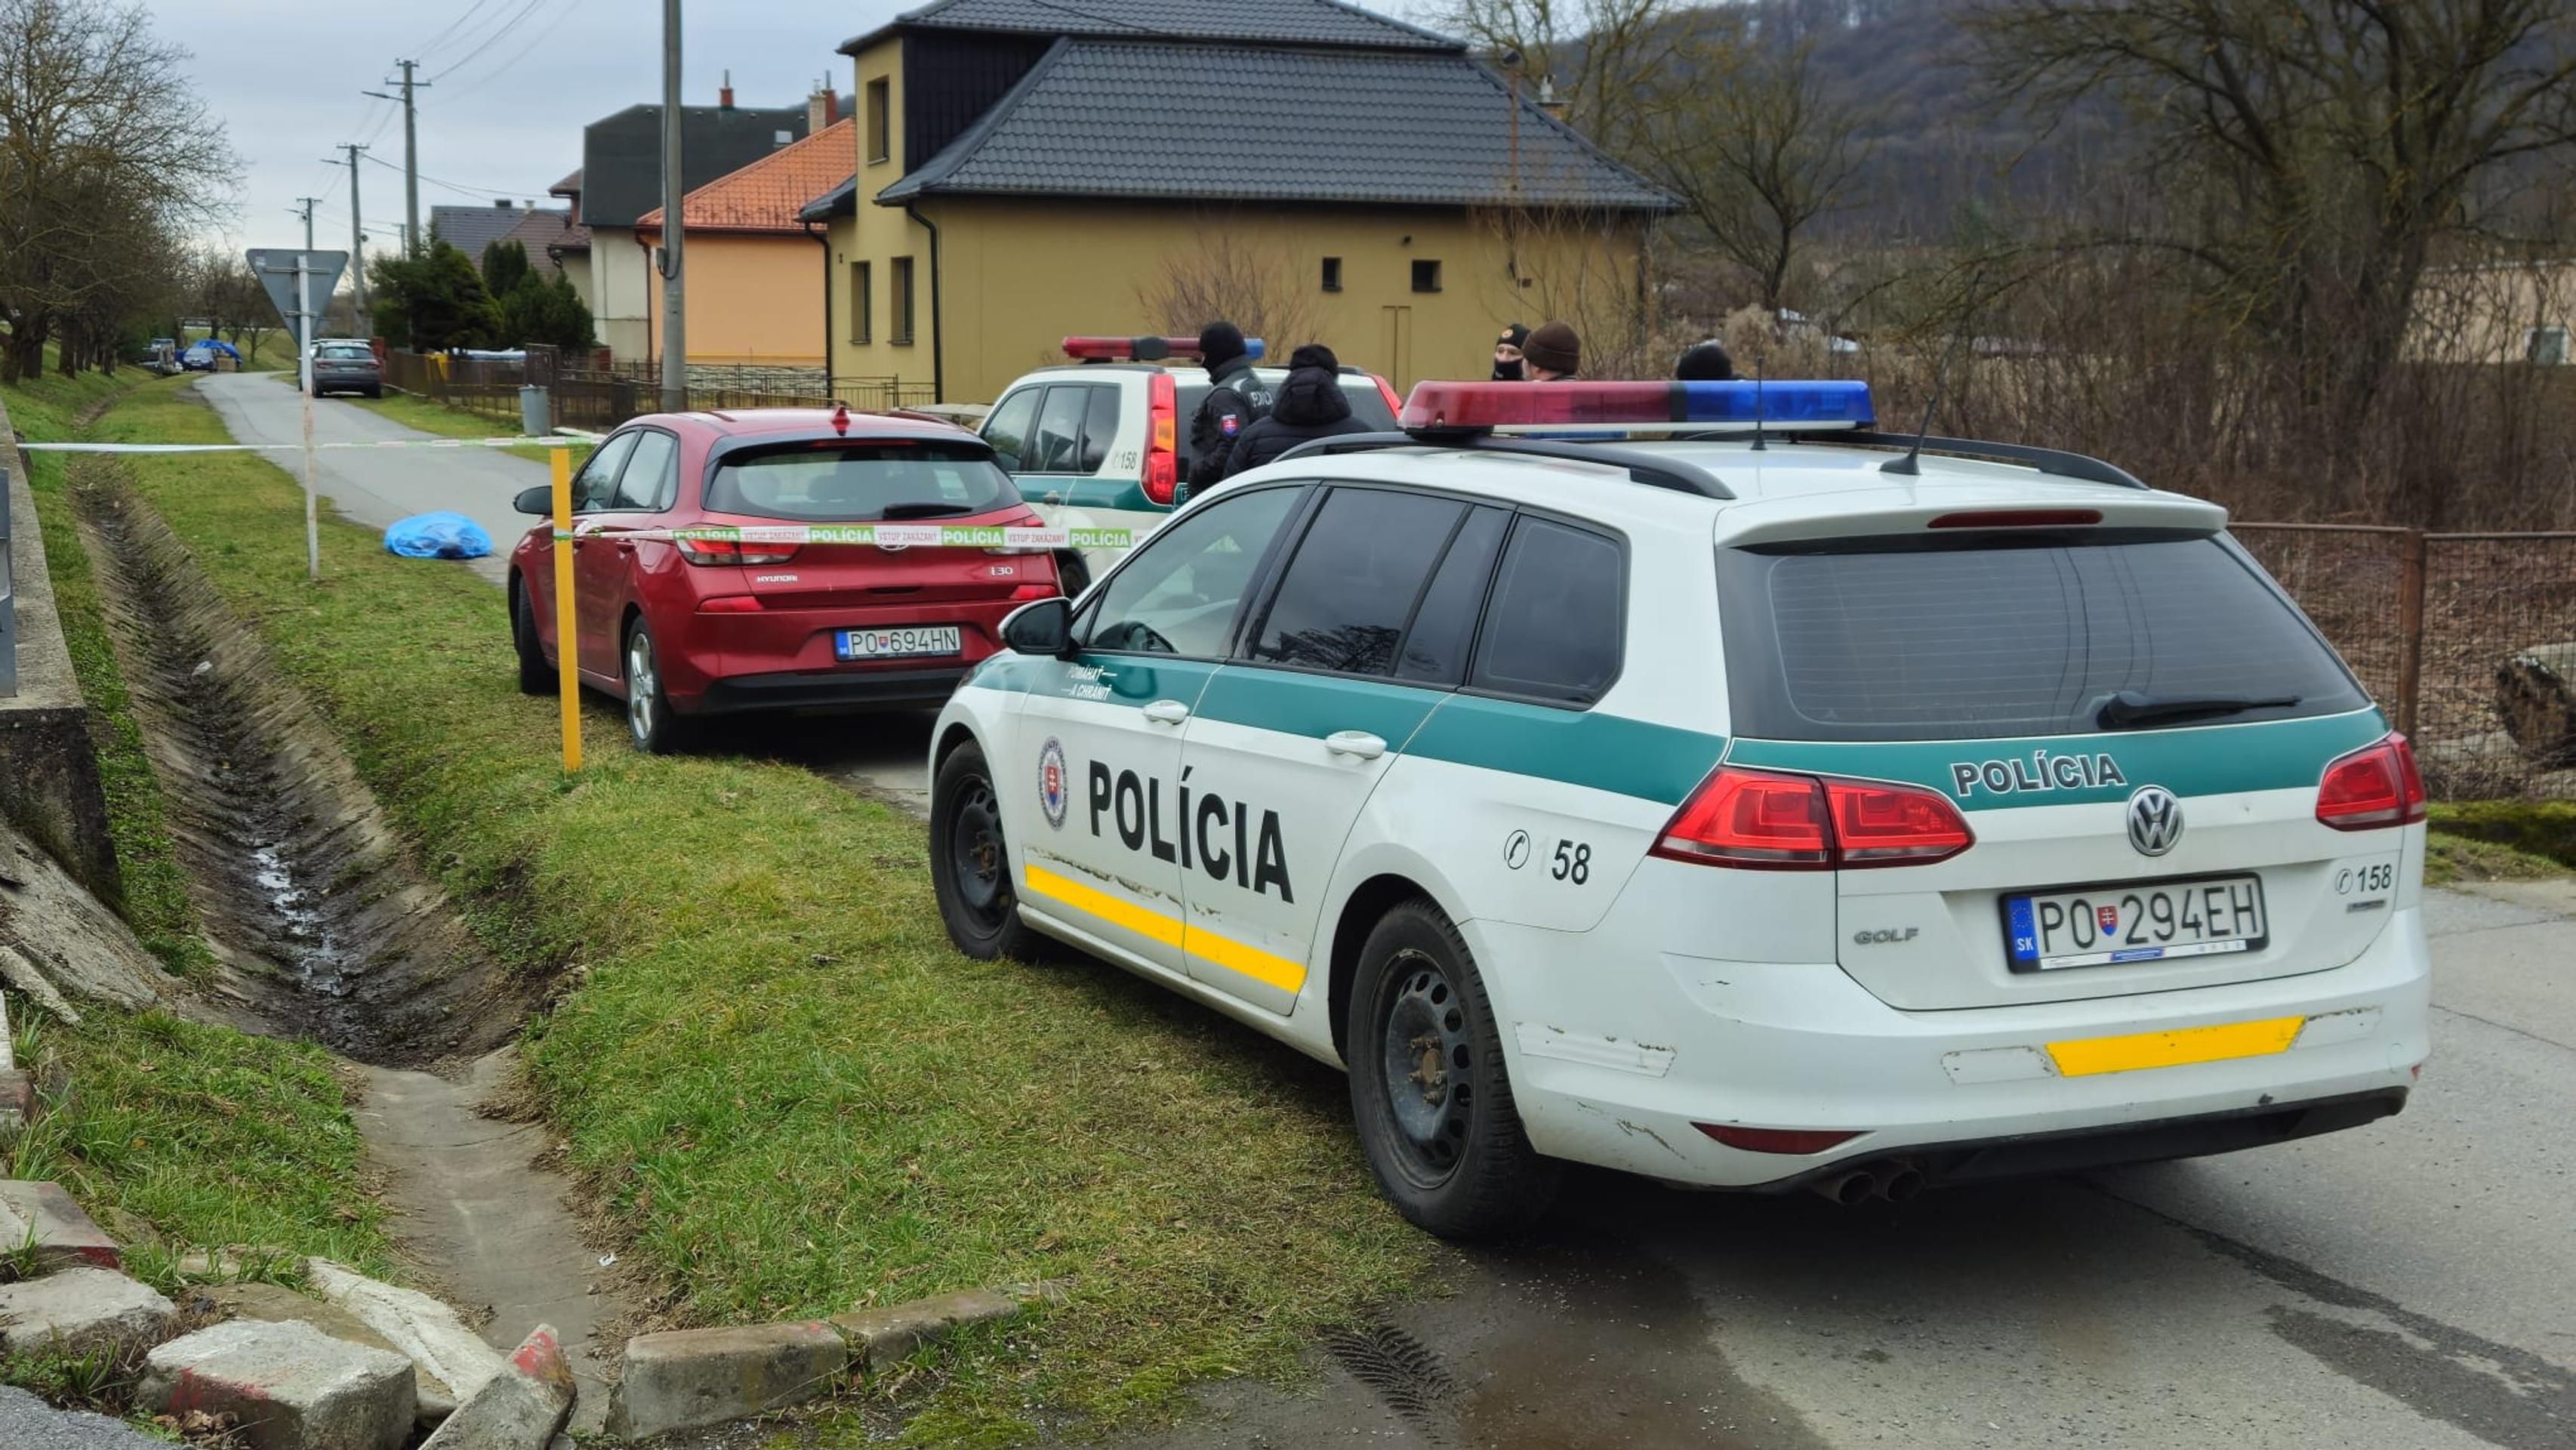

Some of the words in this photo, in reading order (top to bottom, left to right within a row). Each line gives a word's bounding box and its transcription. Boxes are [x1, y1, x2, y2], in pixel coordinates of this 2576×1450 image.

[1121, 451, 1137, 470] 158
[812, 527, 872, 542] POLÍCIA
[944, 528, 1003, 545] POLÍCIA
[1071, 529, 1129, 547] POLÍCIA
[851, 633, 878, 653] PO
[890, 629, 957, 652] 694HN
[1950, 749, 2128, 797] POLÍCIA
[1089, 759, 1294, 904] POLÍCIA
[2358, 864, 2392, 893] 158
[2039, 899, 2095, 953] PO
[2122, 884, 2257, 945] 294EH
[1853, 928, 1919, 945] GOLF
[2017, 936, 2034, 952] SK
